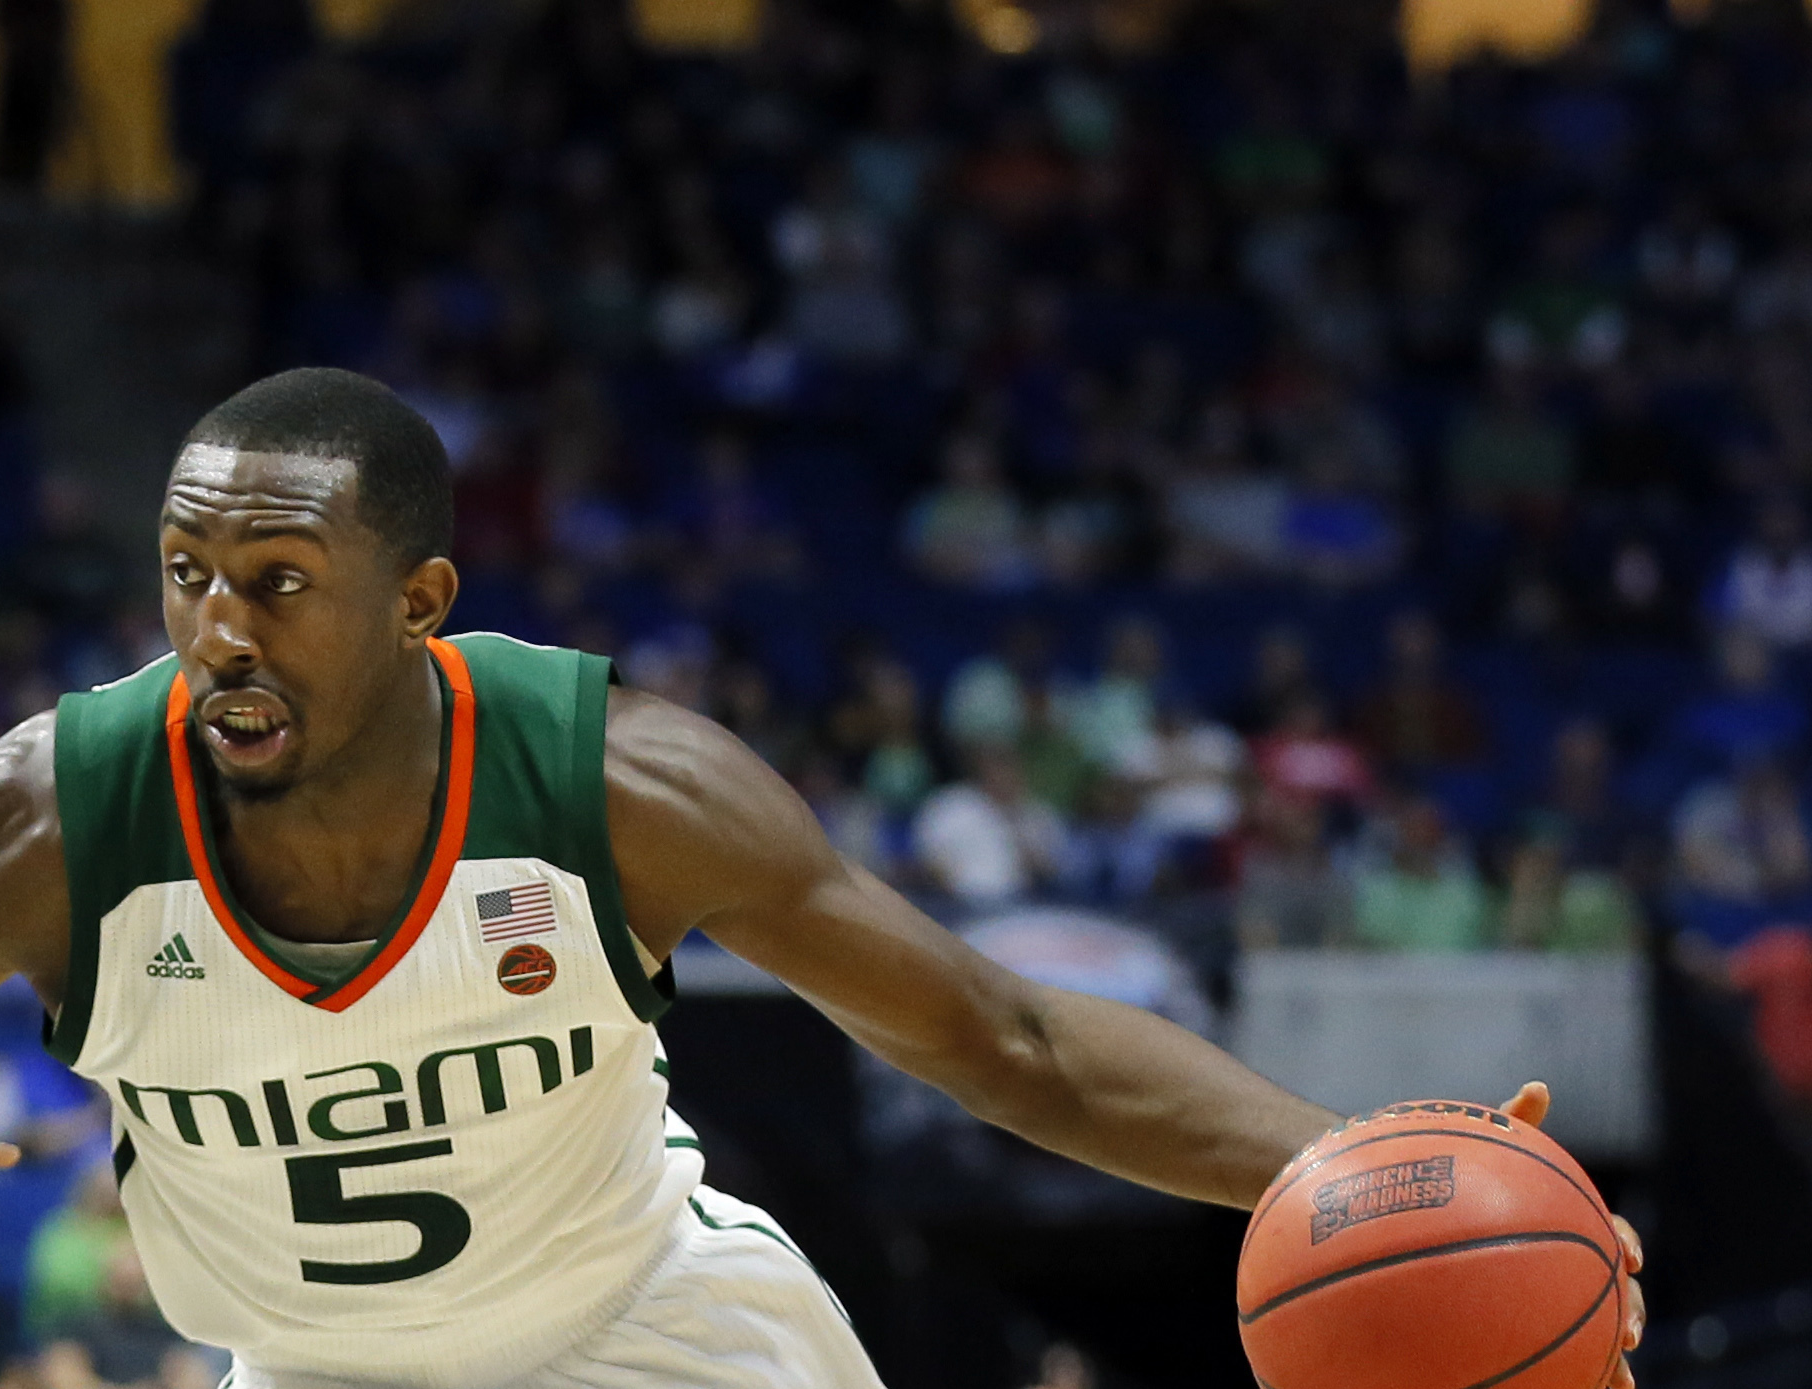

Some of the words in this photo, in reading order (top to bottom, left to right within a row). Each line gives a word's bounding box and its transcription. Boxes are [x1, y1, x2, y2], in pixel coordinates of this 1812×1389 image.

[146, 960, 206, 979] adidas
[1337, 1163, 1414, 1201] MARCH
[1348, 1180, 1454, 1217] MADNESS
[285, 1138, 472, 1286] 5
